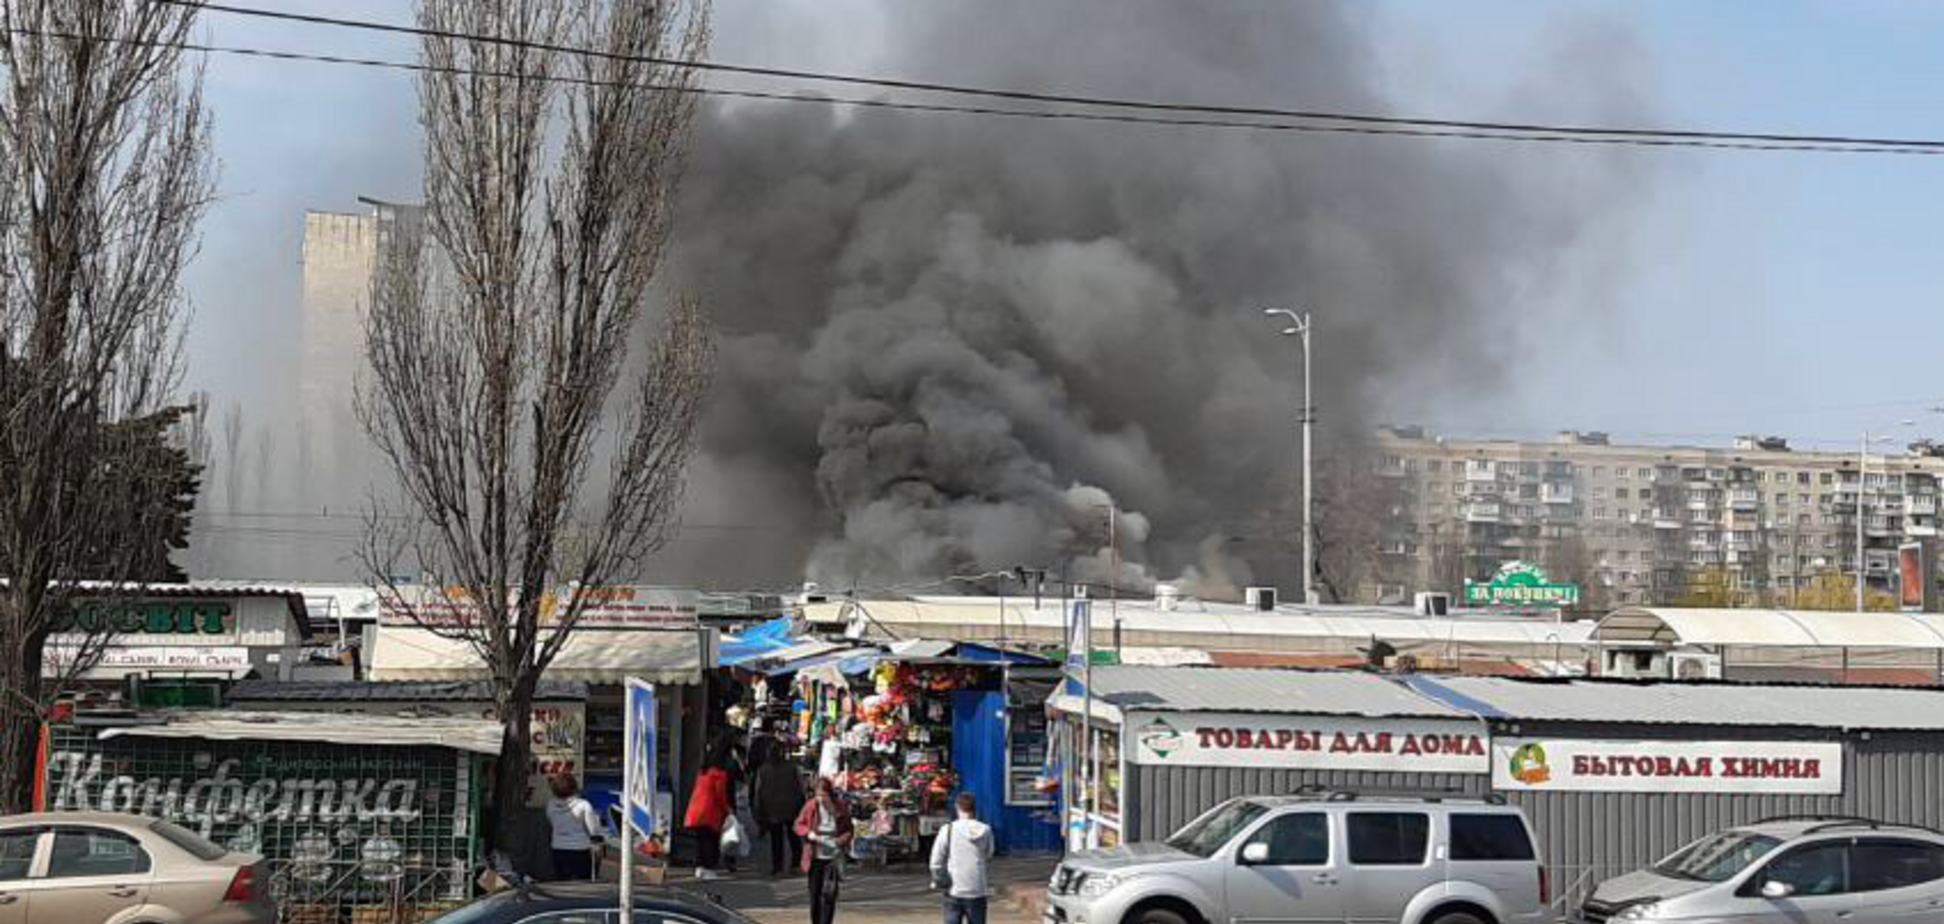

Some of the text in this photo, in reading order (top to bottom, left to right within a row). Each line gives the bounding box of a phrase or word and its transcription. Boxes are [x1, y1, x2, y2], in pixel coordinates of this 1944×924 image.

[1195, 726, 1322, 752] ТОВАРЫ
[1329, 731, 1393, 755] ДЛЯ
[1400, 732, 1486, 756] ДОМА
[1571, 754, 1821, 779] БЫТОВАЯ ХИМИЯ
[50, 750, 419, 842] Конфетка
